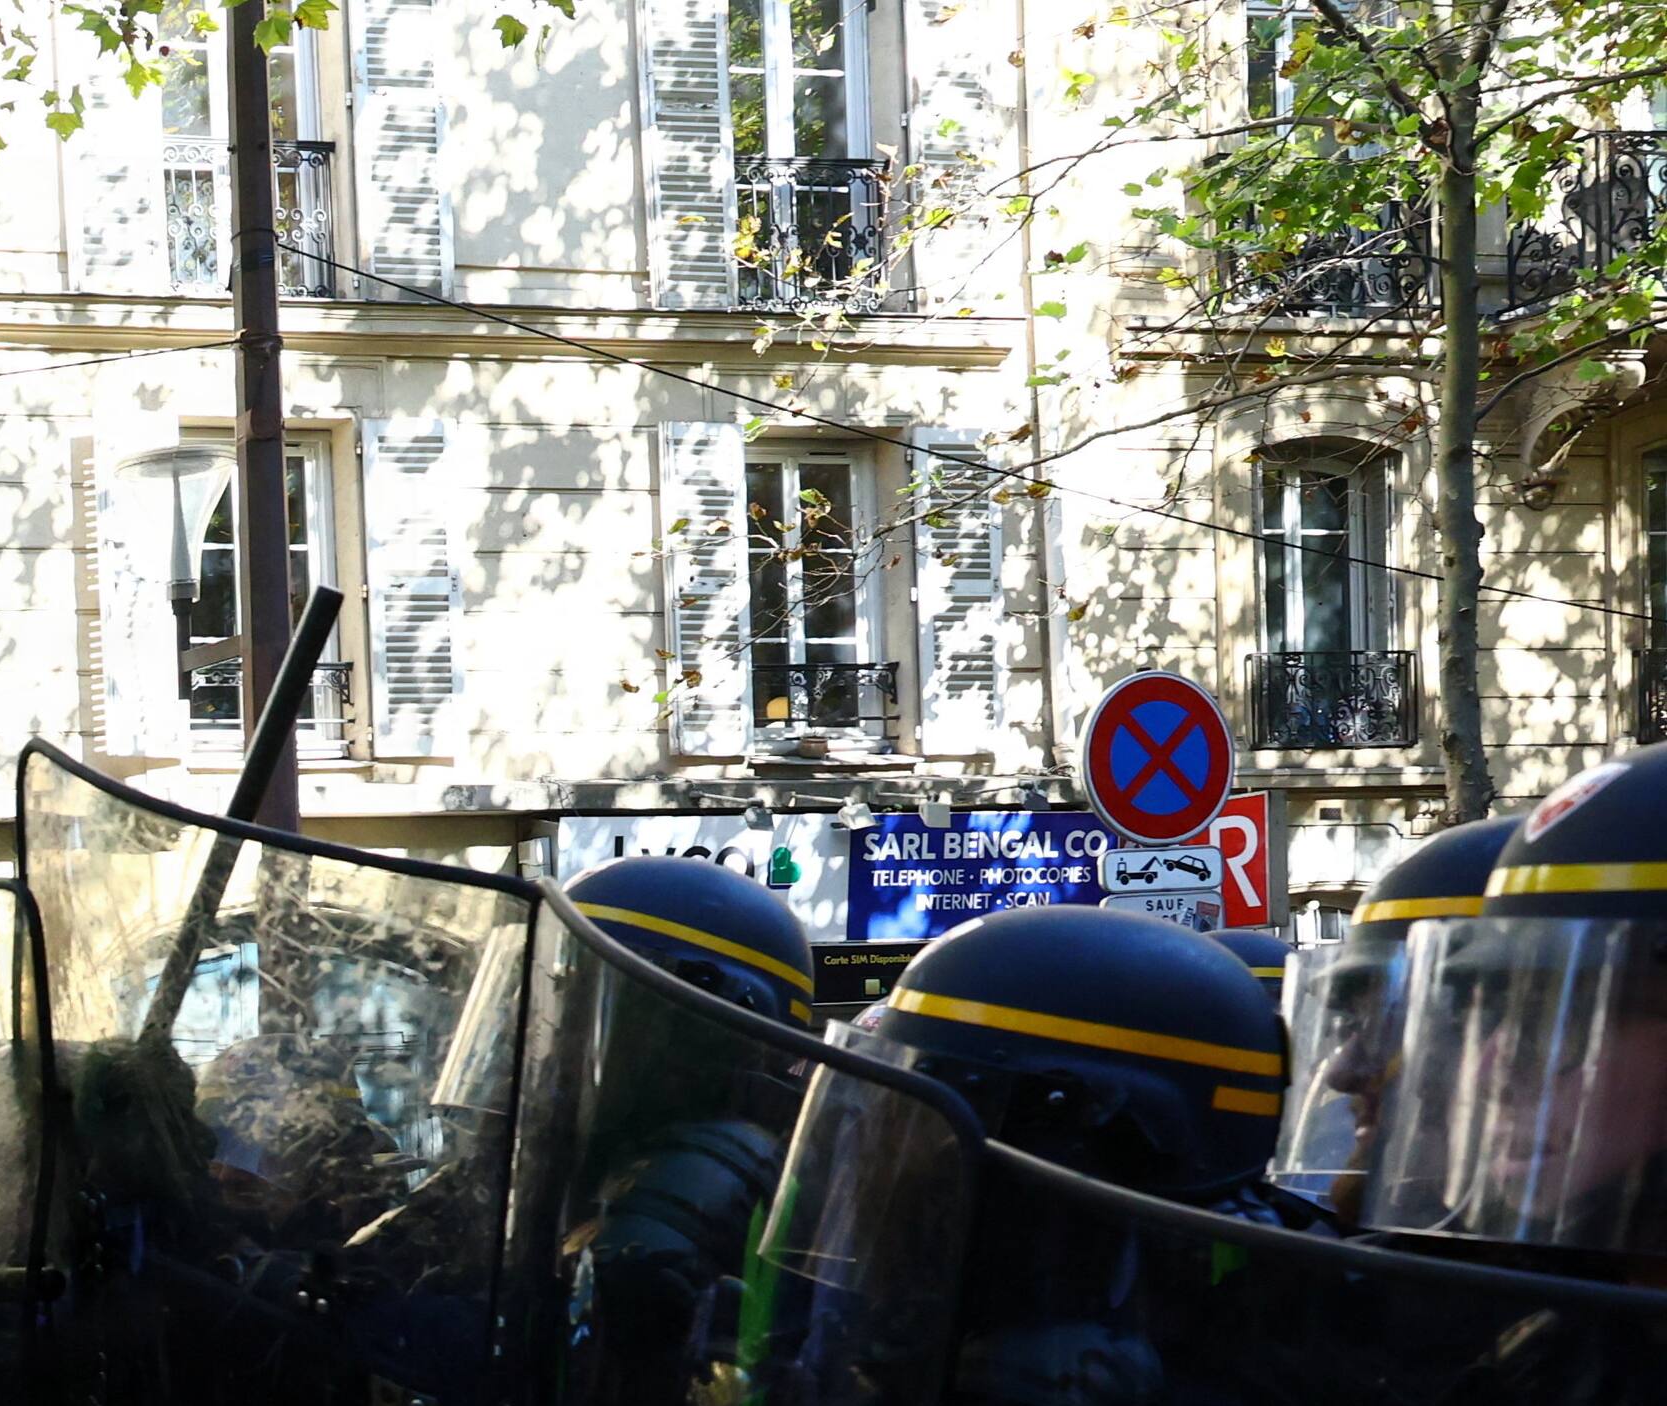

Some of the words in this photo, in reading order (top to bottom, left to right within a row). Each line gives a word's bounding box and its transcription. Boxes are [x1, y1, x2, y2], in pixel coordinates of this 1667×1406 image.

[863, 832, 936, 861] SARL
[943, 830, 1059, 859] BENGAL
[871, 868, 965, 887] TELEPHONE
[979, 866, 1092, 885] PHOTOCOPIES
[915, 892, 992, 912] INTERNET
[1004, 891, 1051, 909] SCAN
[1145, 898, 1184, 912] SAUF
[824, 955, 849, 965] Carte
[851, 955, 867, 964] SIM
